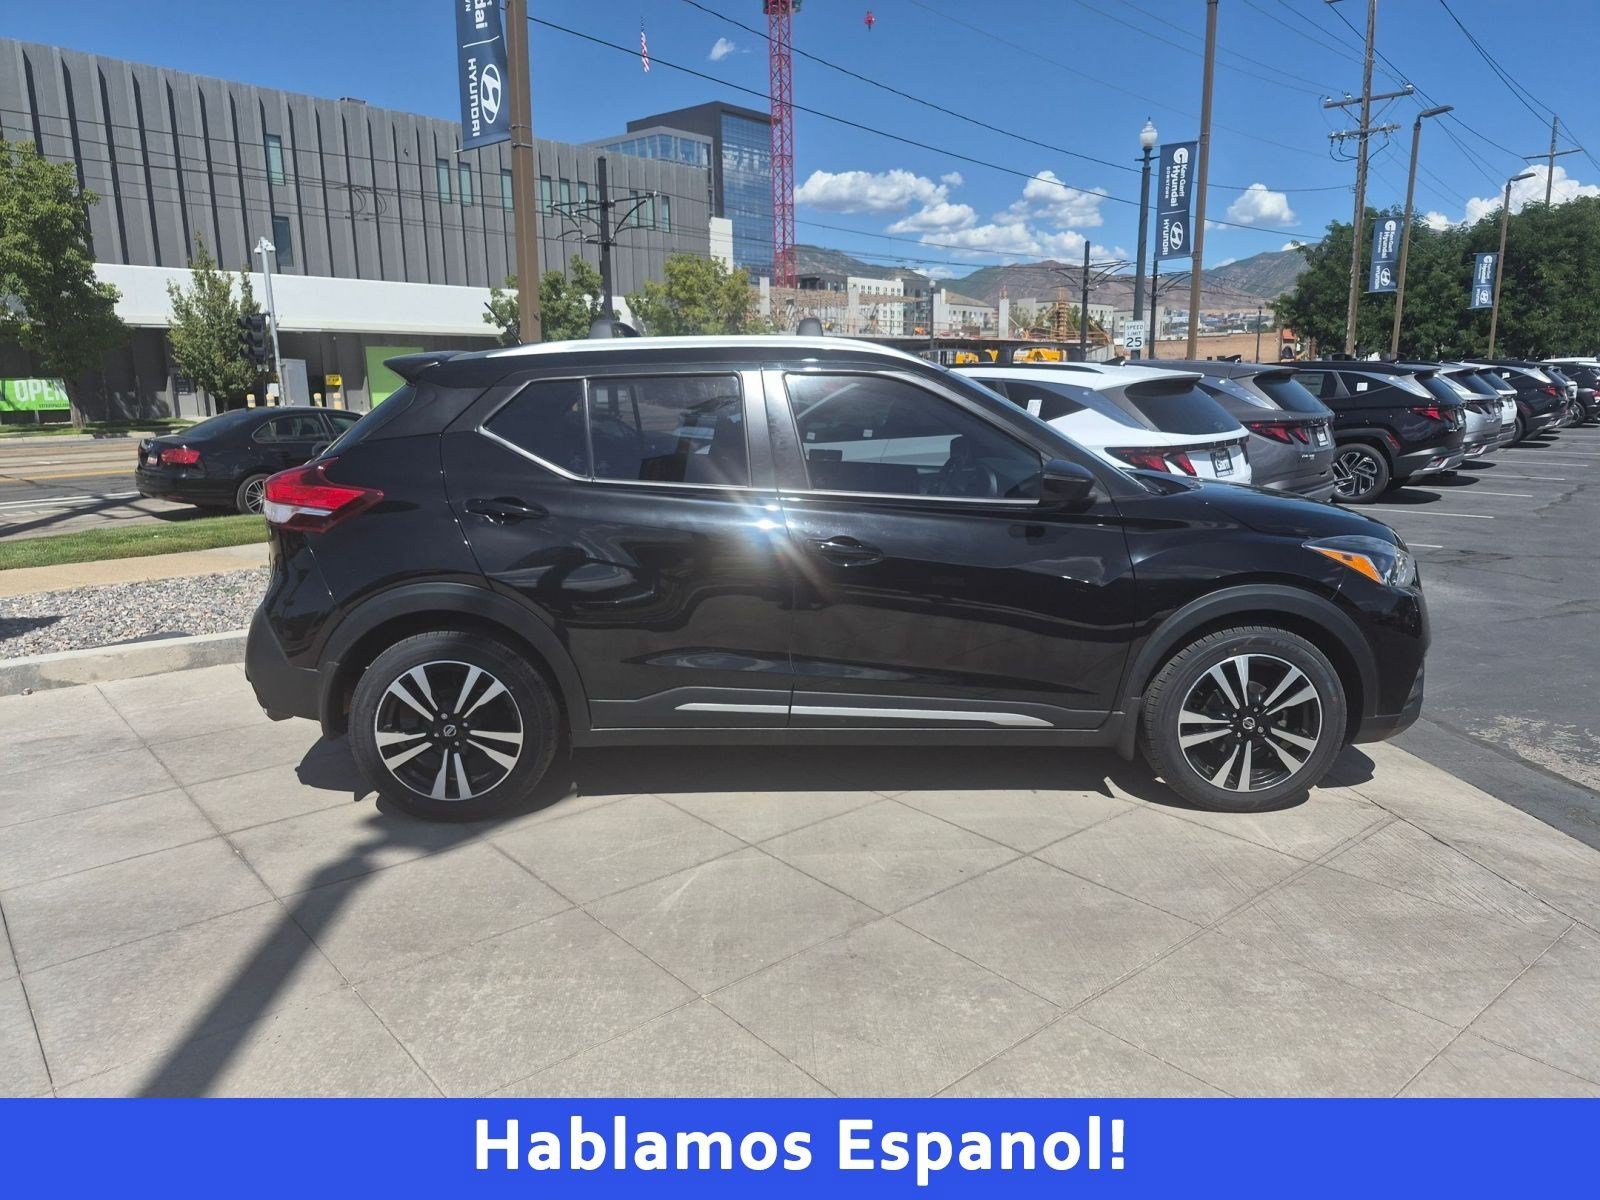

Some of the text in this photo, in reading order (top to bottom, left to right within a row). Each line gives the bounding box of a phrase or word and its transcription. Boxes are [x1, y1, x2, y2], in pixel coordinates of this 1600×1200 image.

[467, 57, 481, 137] HYUNDAI
[1170, 165, 1180, 207] Hyundai
[1178, 164, 1188, 197] Ken Garff
[1162, 219, 1170, 255] HYUNDAI
[1126, 337, 1142, 347] 25
[14, 379, 69, 402] OPEN
